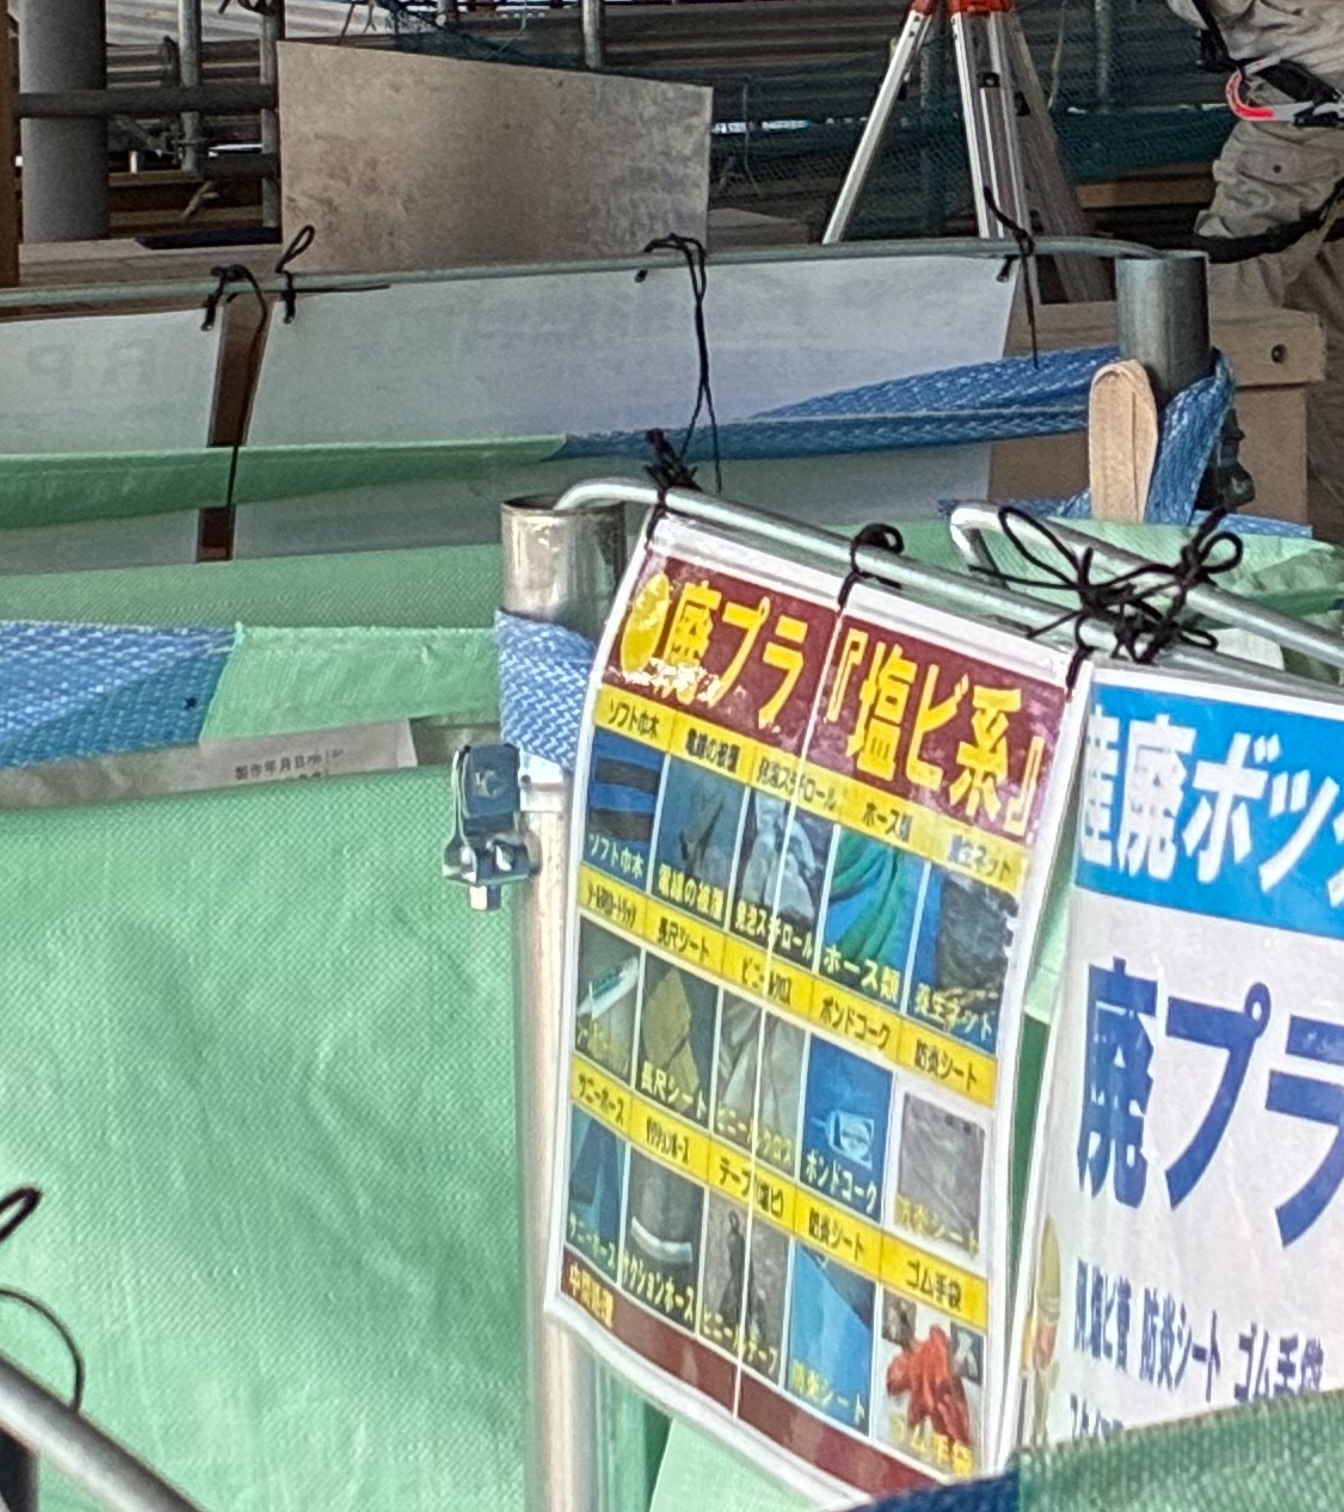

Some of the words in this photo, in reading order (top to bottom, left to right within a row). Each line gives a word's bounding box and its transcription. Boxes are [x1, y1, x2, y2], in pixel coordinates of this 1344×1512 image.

[822, 943, 901, 1003] ホース類
[819, 994, 891, 1051] ボンドコーク
[804, 1150, 878, 1214] ボンドコーク
